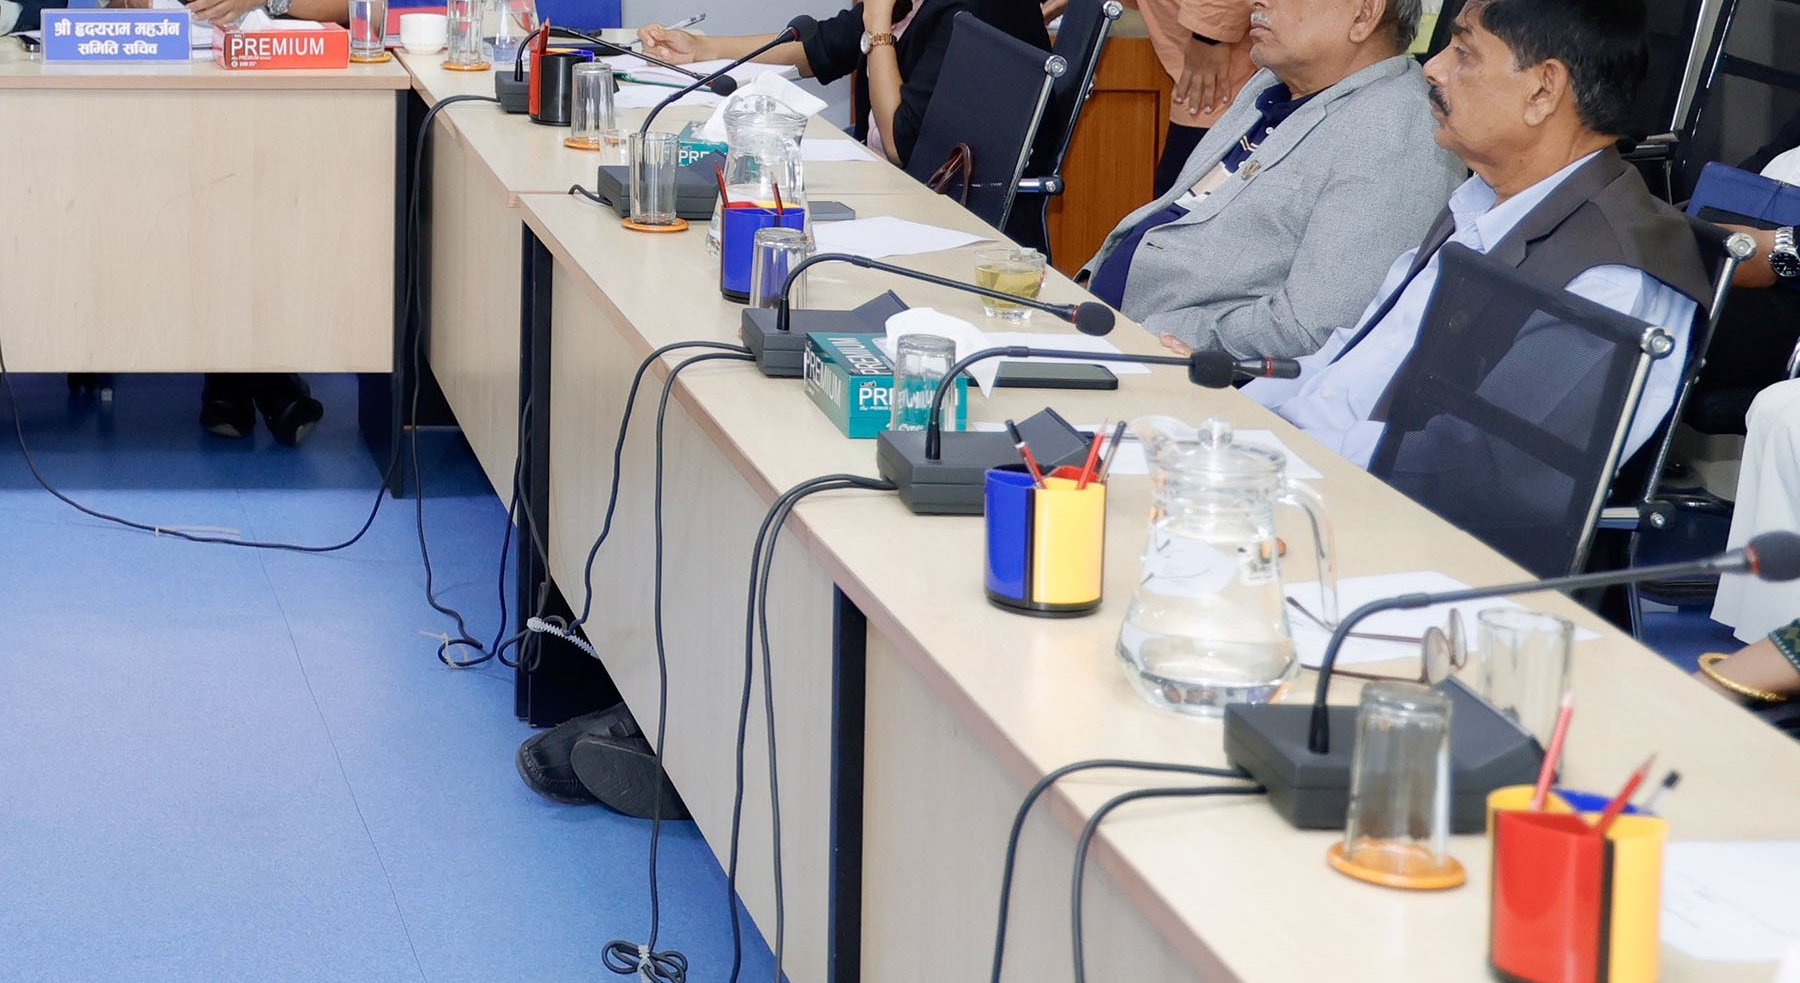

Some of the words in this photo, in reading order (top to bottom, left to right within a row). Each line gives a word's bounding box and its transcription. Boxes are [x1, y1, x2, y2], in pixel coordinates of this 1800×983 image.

[54, 18, 72, 36] श्री
[134, 18, 181, 37] महर्जन
[77, 40, 119, 55] समिति
[122, 40, 158, 55] सचिव
[231, 37, 326, 56] PREMIUM
[804, 346, 842, 408] PREMIUM
